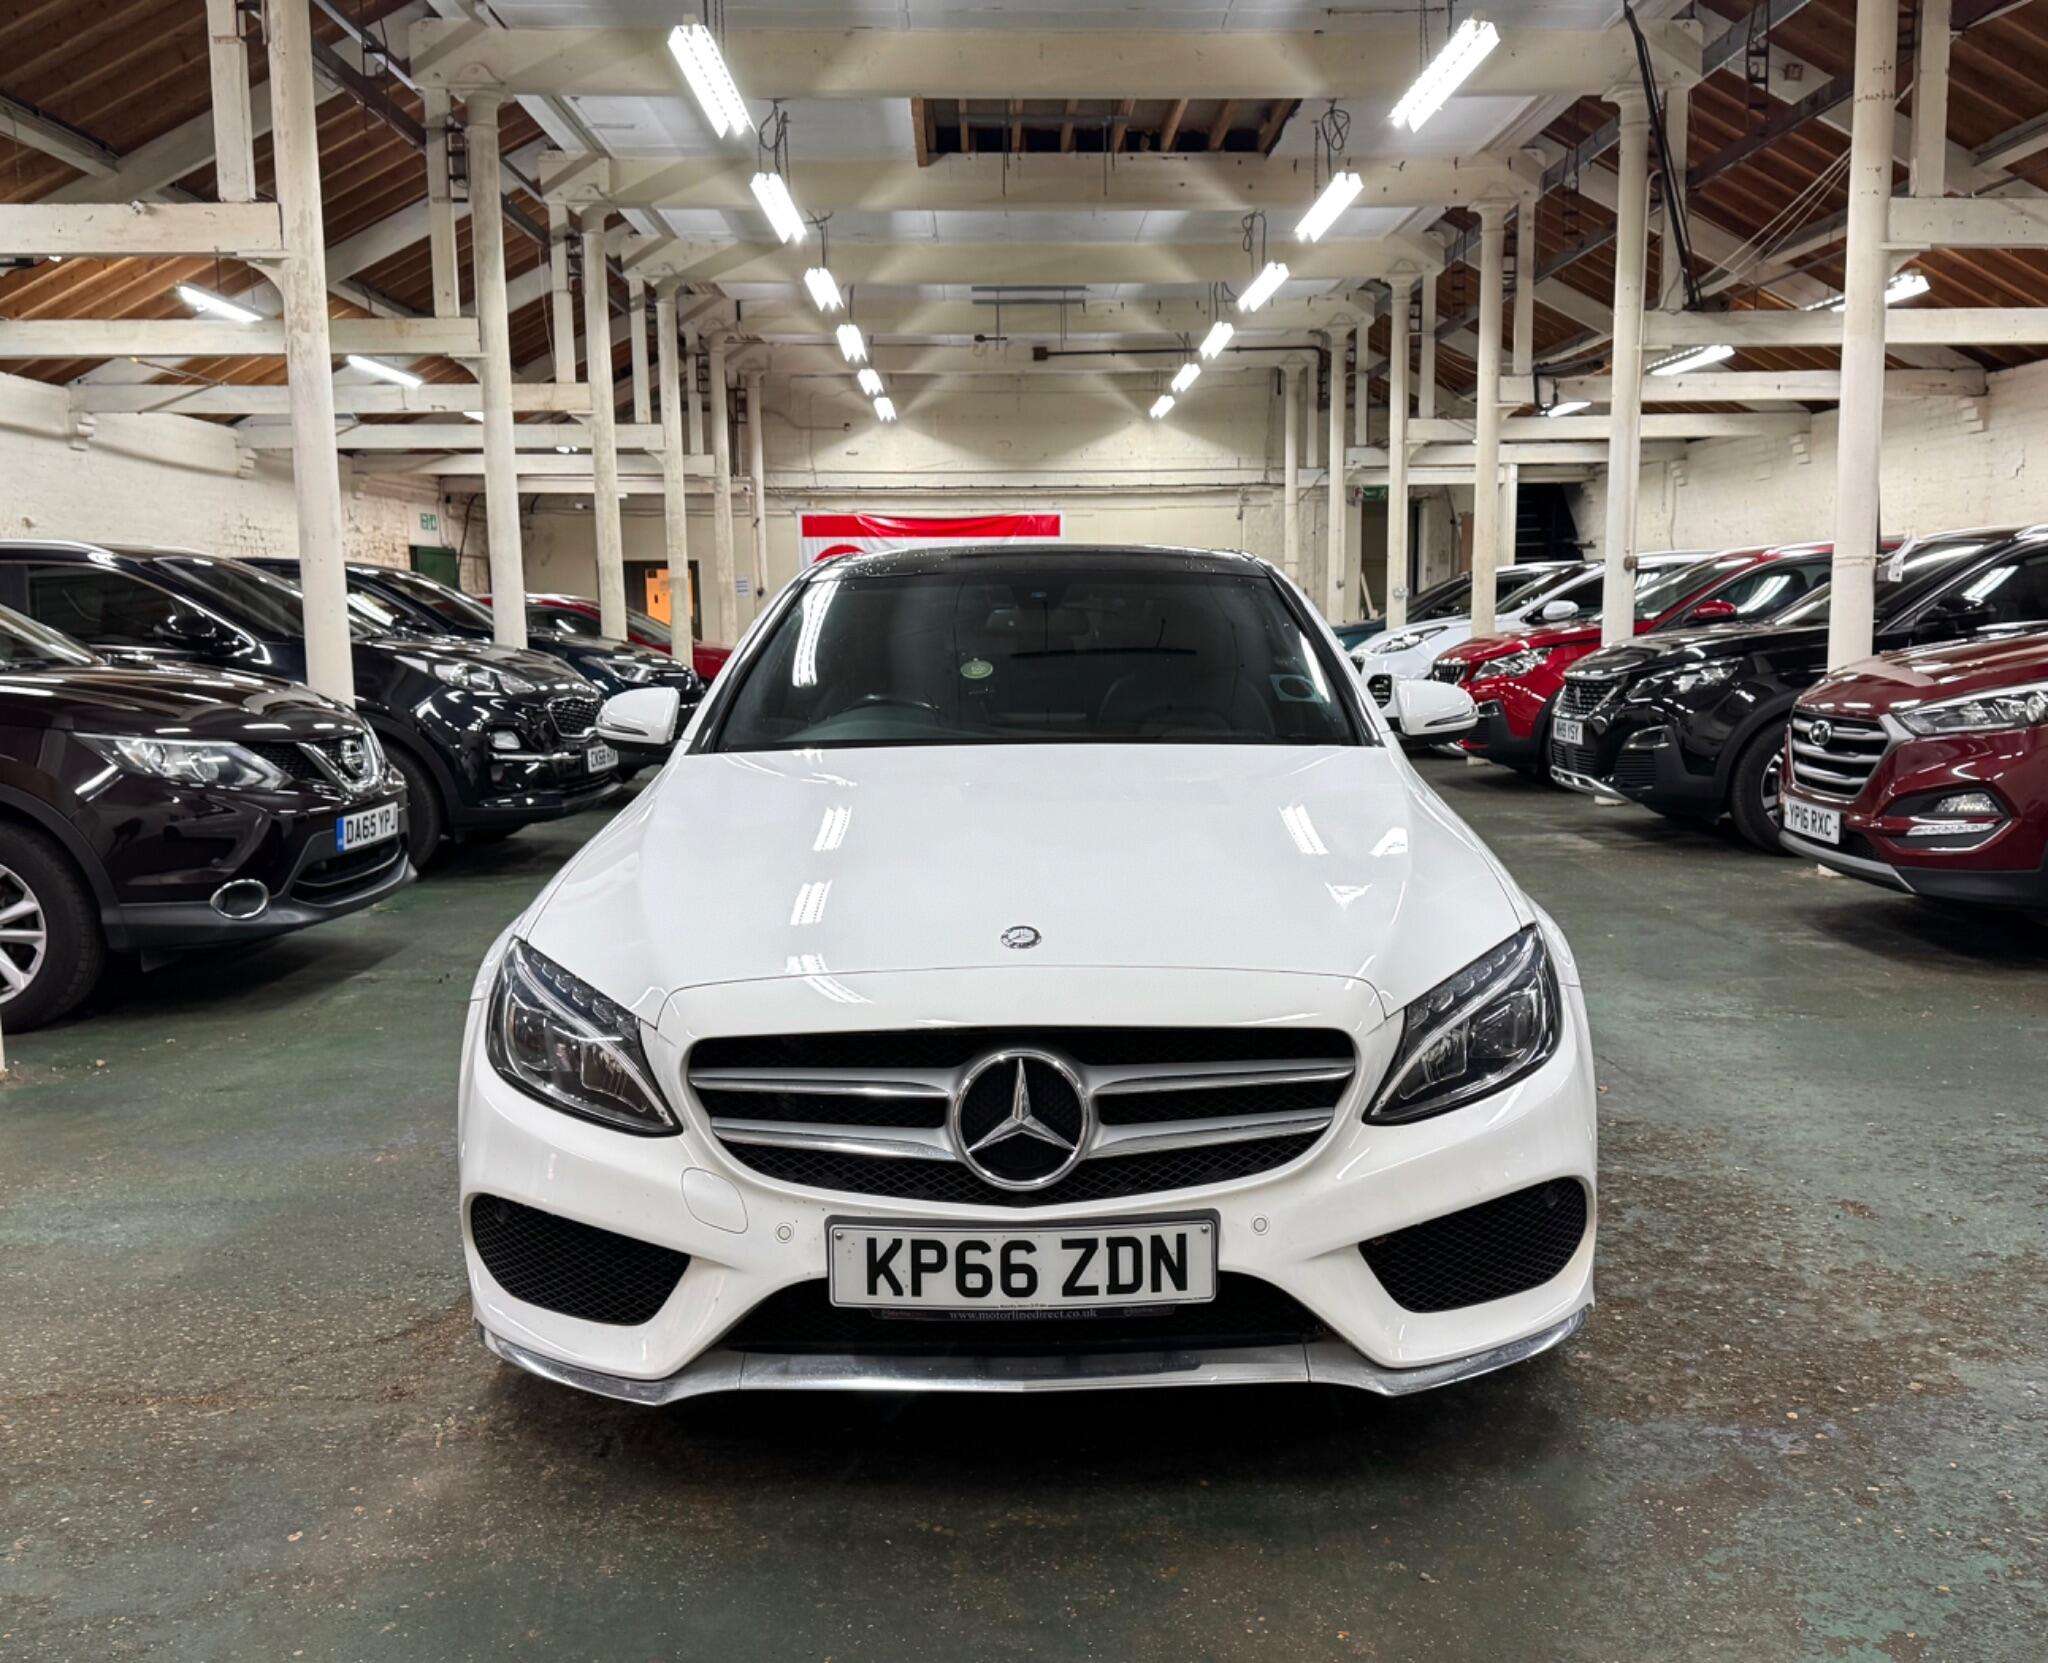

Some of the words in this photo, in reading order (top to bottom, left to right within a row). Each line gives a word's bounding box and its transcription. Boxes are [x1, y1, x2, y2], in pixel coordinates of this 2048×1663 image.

[346, 812, 376, 844] DA65
[1811, 809, 1832, 836] RXC
[866, 1237, 1039, 1298] KP66
[1061, 1233, 1188, 1298] ZDN
[949, 1308, 1098, 1321] www.motorlinedirect.co.uk
